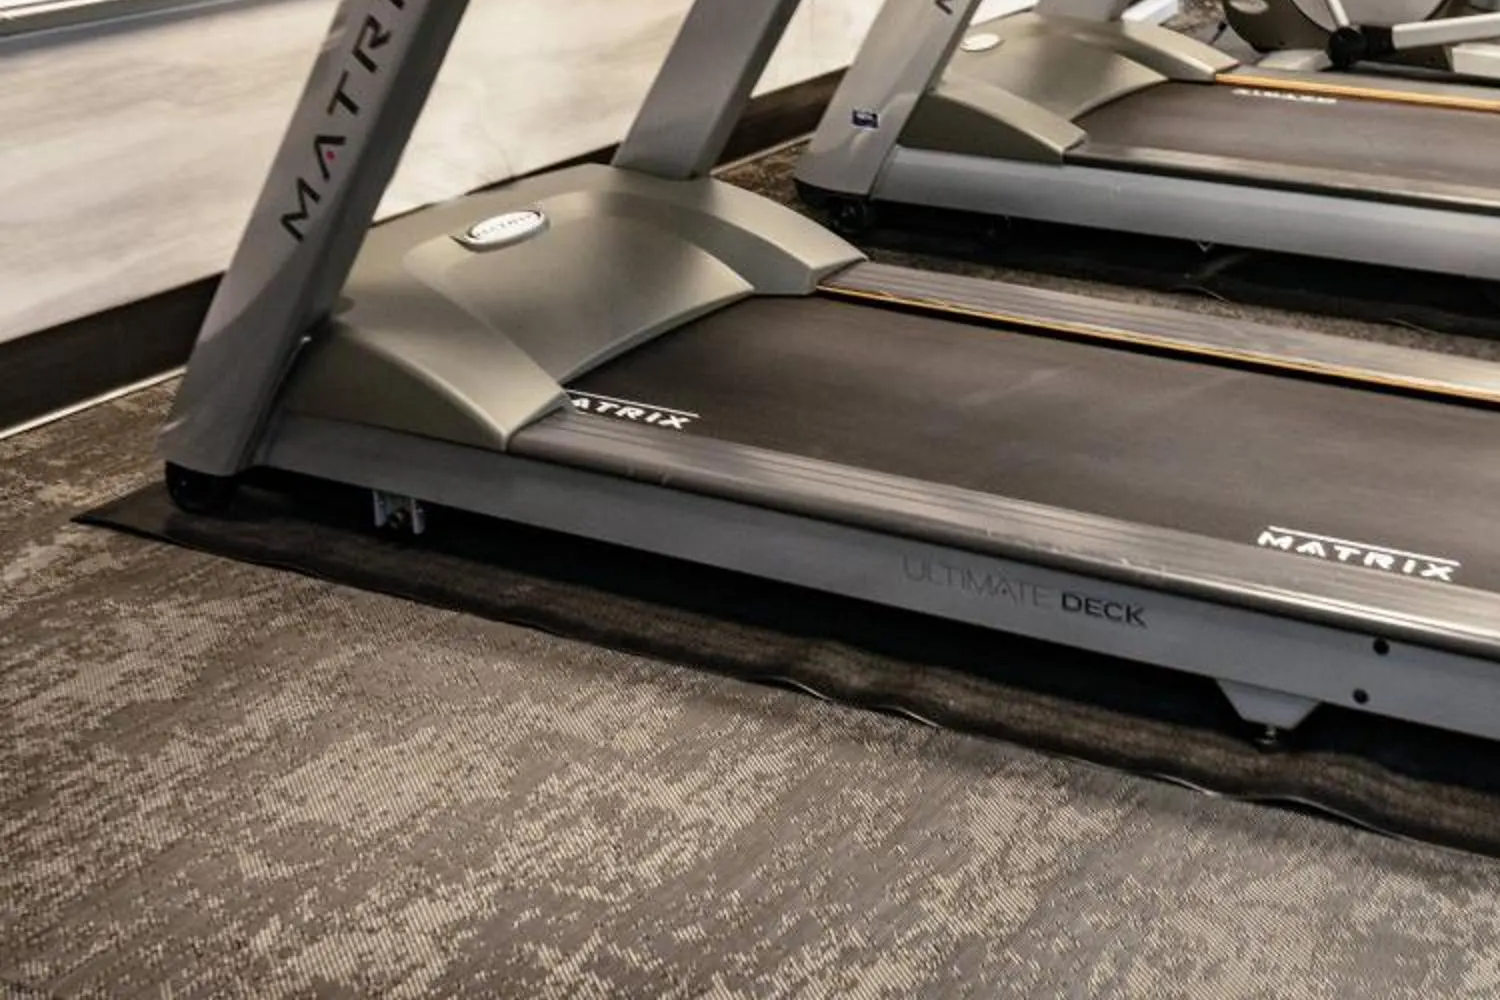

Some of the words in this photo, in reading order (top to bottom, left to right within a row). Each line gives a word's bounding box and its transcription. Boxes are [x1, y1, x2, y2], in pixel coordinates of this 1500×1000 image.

[571, 397, 693, 429] ATRIX
[1257, 531, 1454, 581] MATRIX
[903, 552, 1050, 608] ULTIMATE
[1060, 592, 1147, 628] DECK
